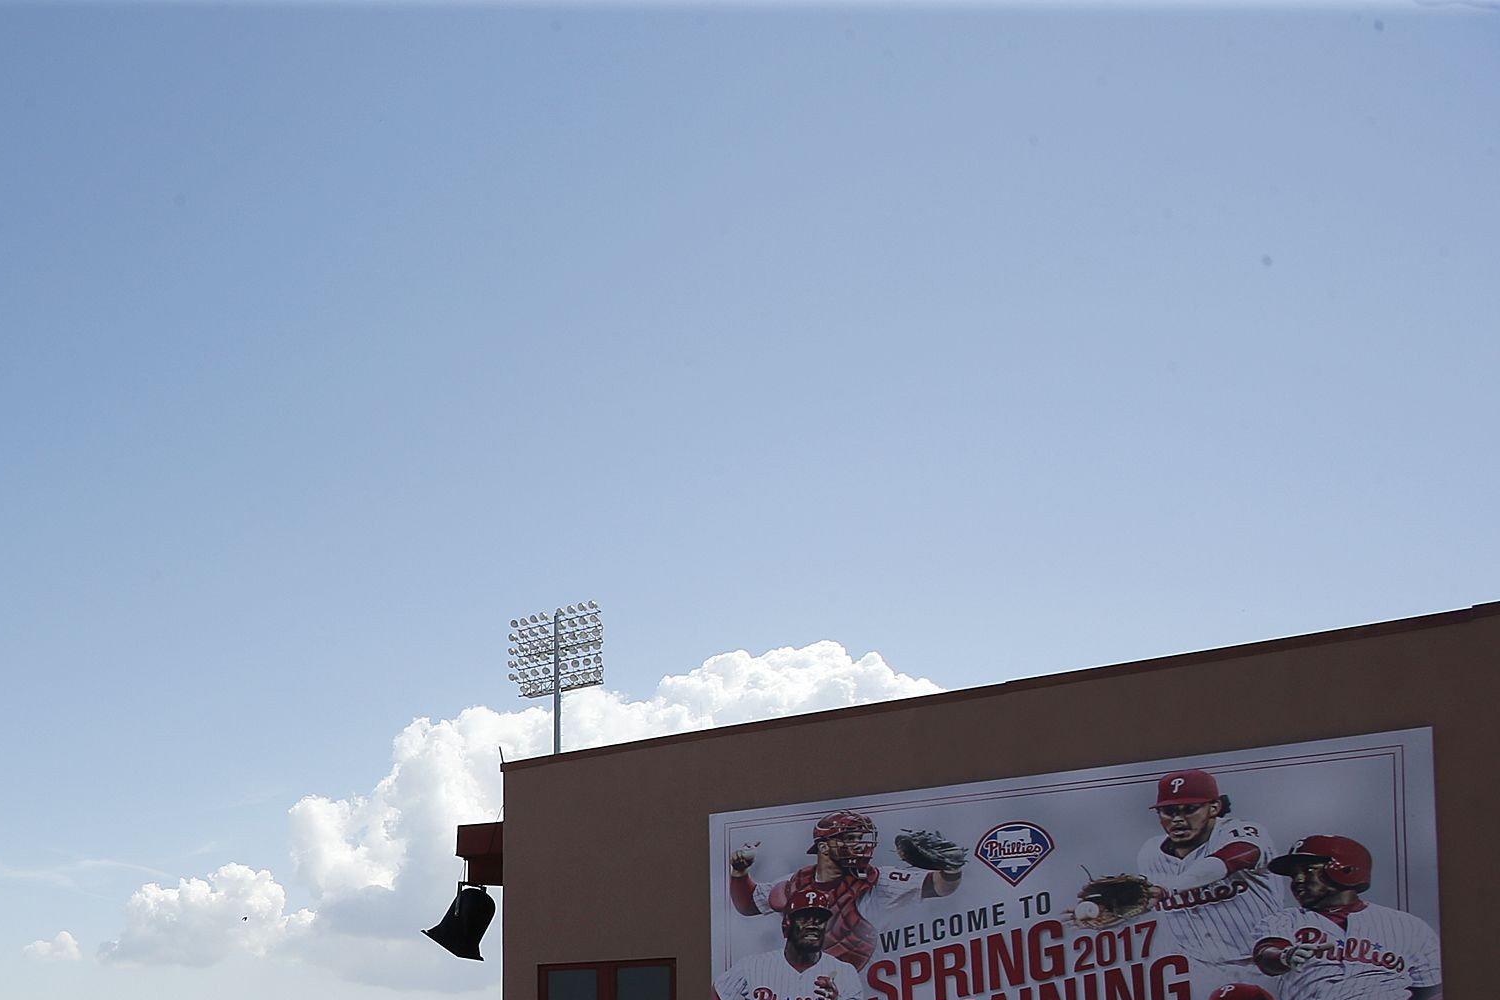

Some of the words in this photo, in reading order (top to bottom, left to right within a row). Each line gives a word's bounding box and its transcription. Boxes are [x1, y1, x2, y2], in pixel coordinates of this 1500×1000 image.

[1170, 777, 1185, 794] P
[981, 841, 1042, 860] Phillies
[805, 892, 817, 905] P
[879, 902, 1006, 953] WELCOME
[1019, 891, 1051, 919] TO
[1073, 920, 1157, 973] 2017
